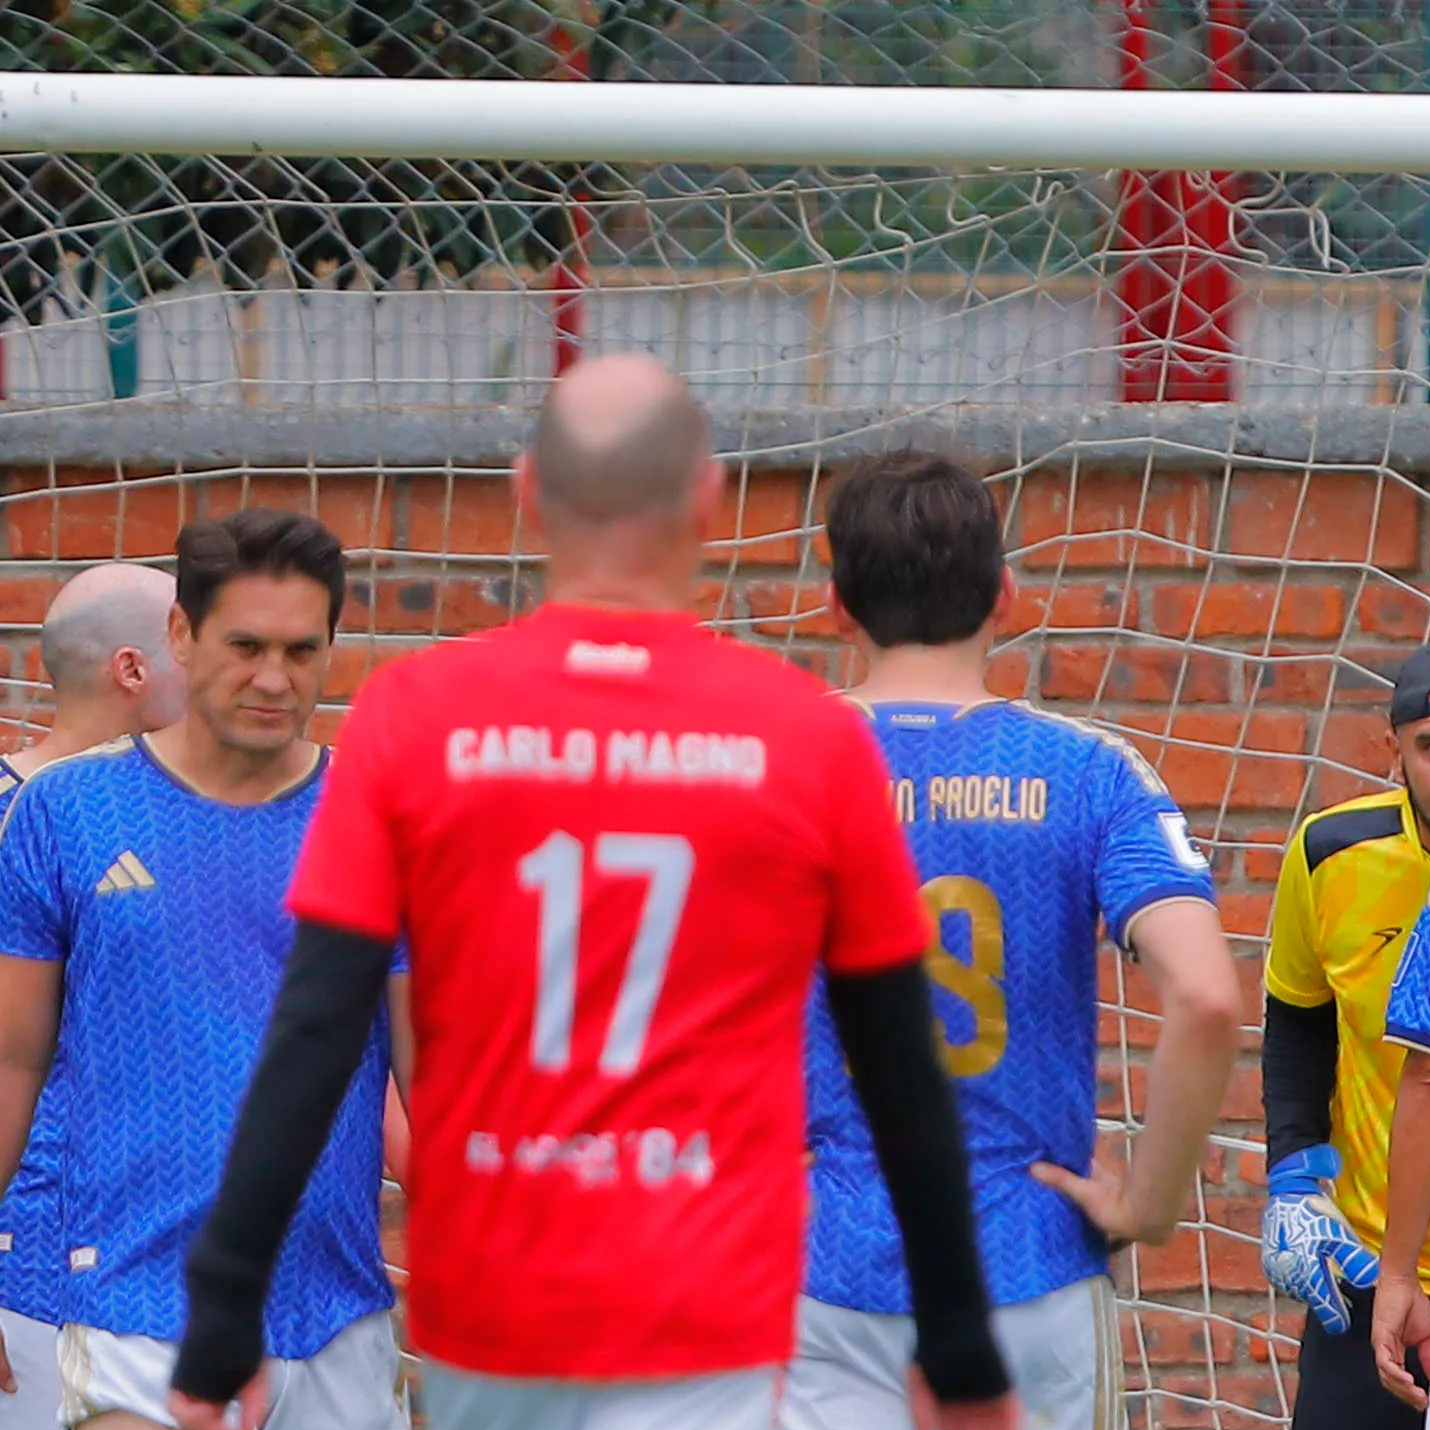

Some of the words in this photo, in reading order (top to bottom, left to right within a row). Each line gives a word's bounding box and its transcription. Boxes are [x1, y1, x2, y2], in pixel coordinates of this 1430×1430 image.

[447, 724, 597, 782] CARLO
[606, 730, 767, 787] MAGNO
[929, 775, 1048, 822] PROELIO
[516, 829, 697, 1077] 17
